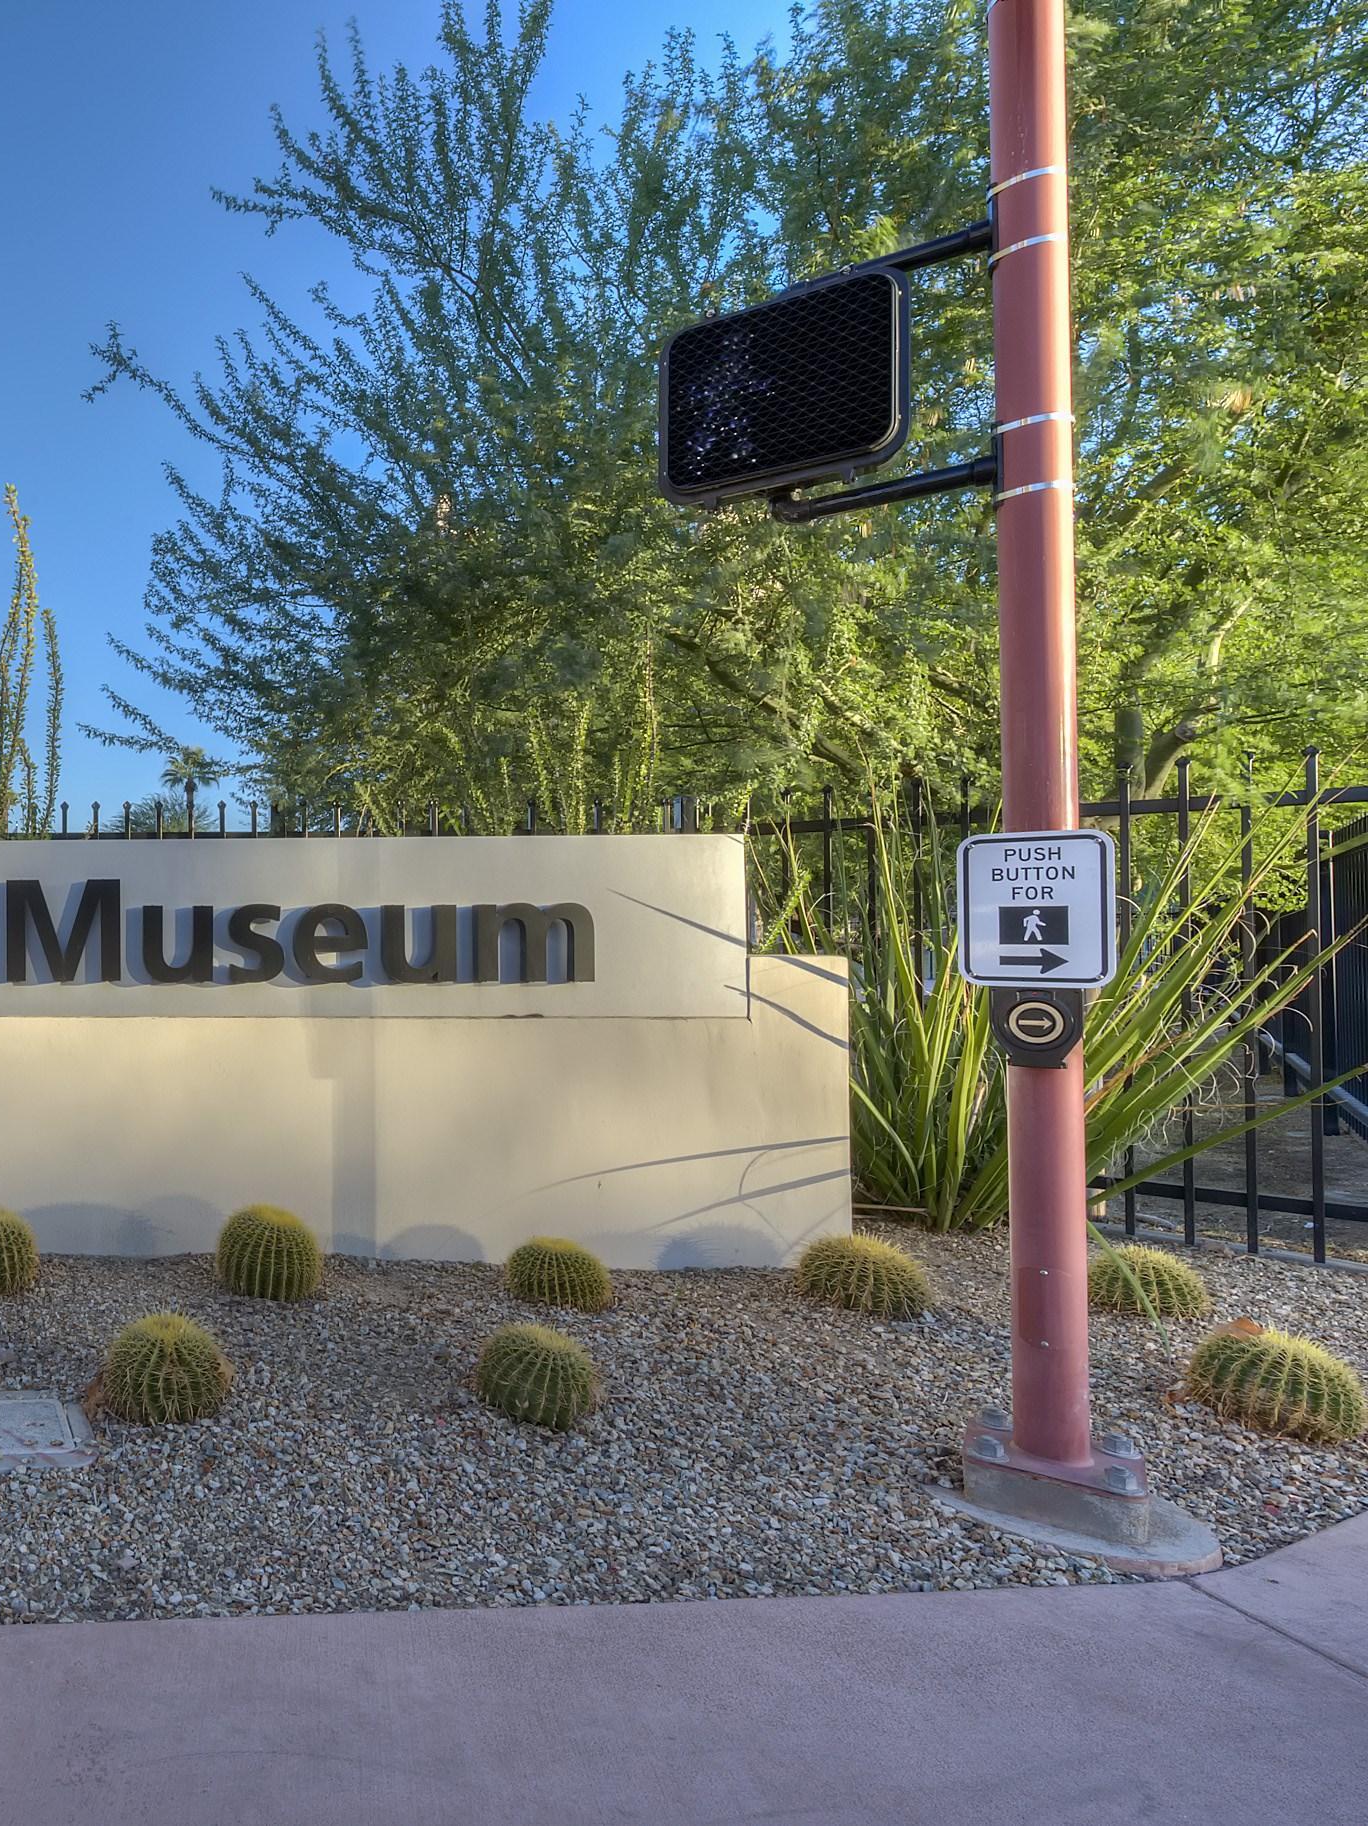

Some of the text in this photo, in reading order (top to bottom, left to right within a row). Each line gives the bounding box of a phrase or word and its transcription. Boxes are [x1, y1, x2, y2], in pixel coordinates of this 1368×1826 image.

[1004, 847, 1062, 862] PUSH
[991, 866, 1075, 882] BUTTON
[1011, 886, 1054, 900] FOR
[5, 878, 595, 983] Museum
